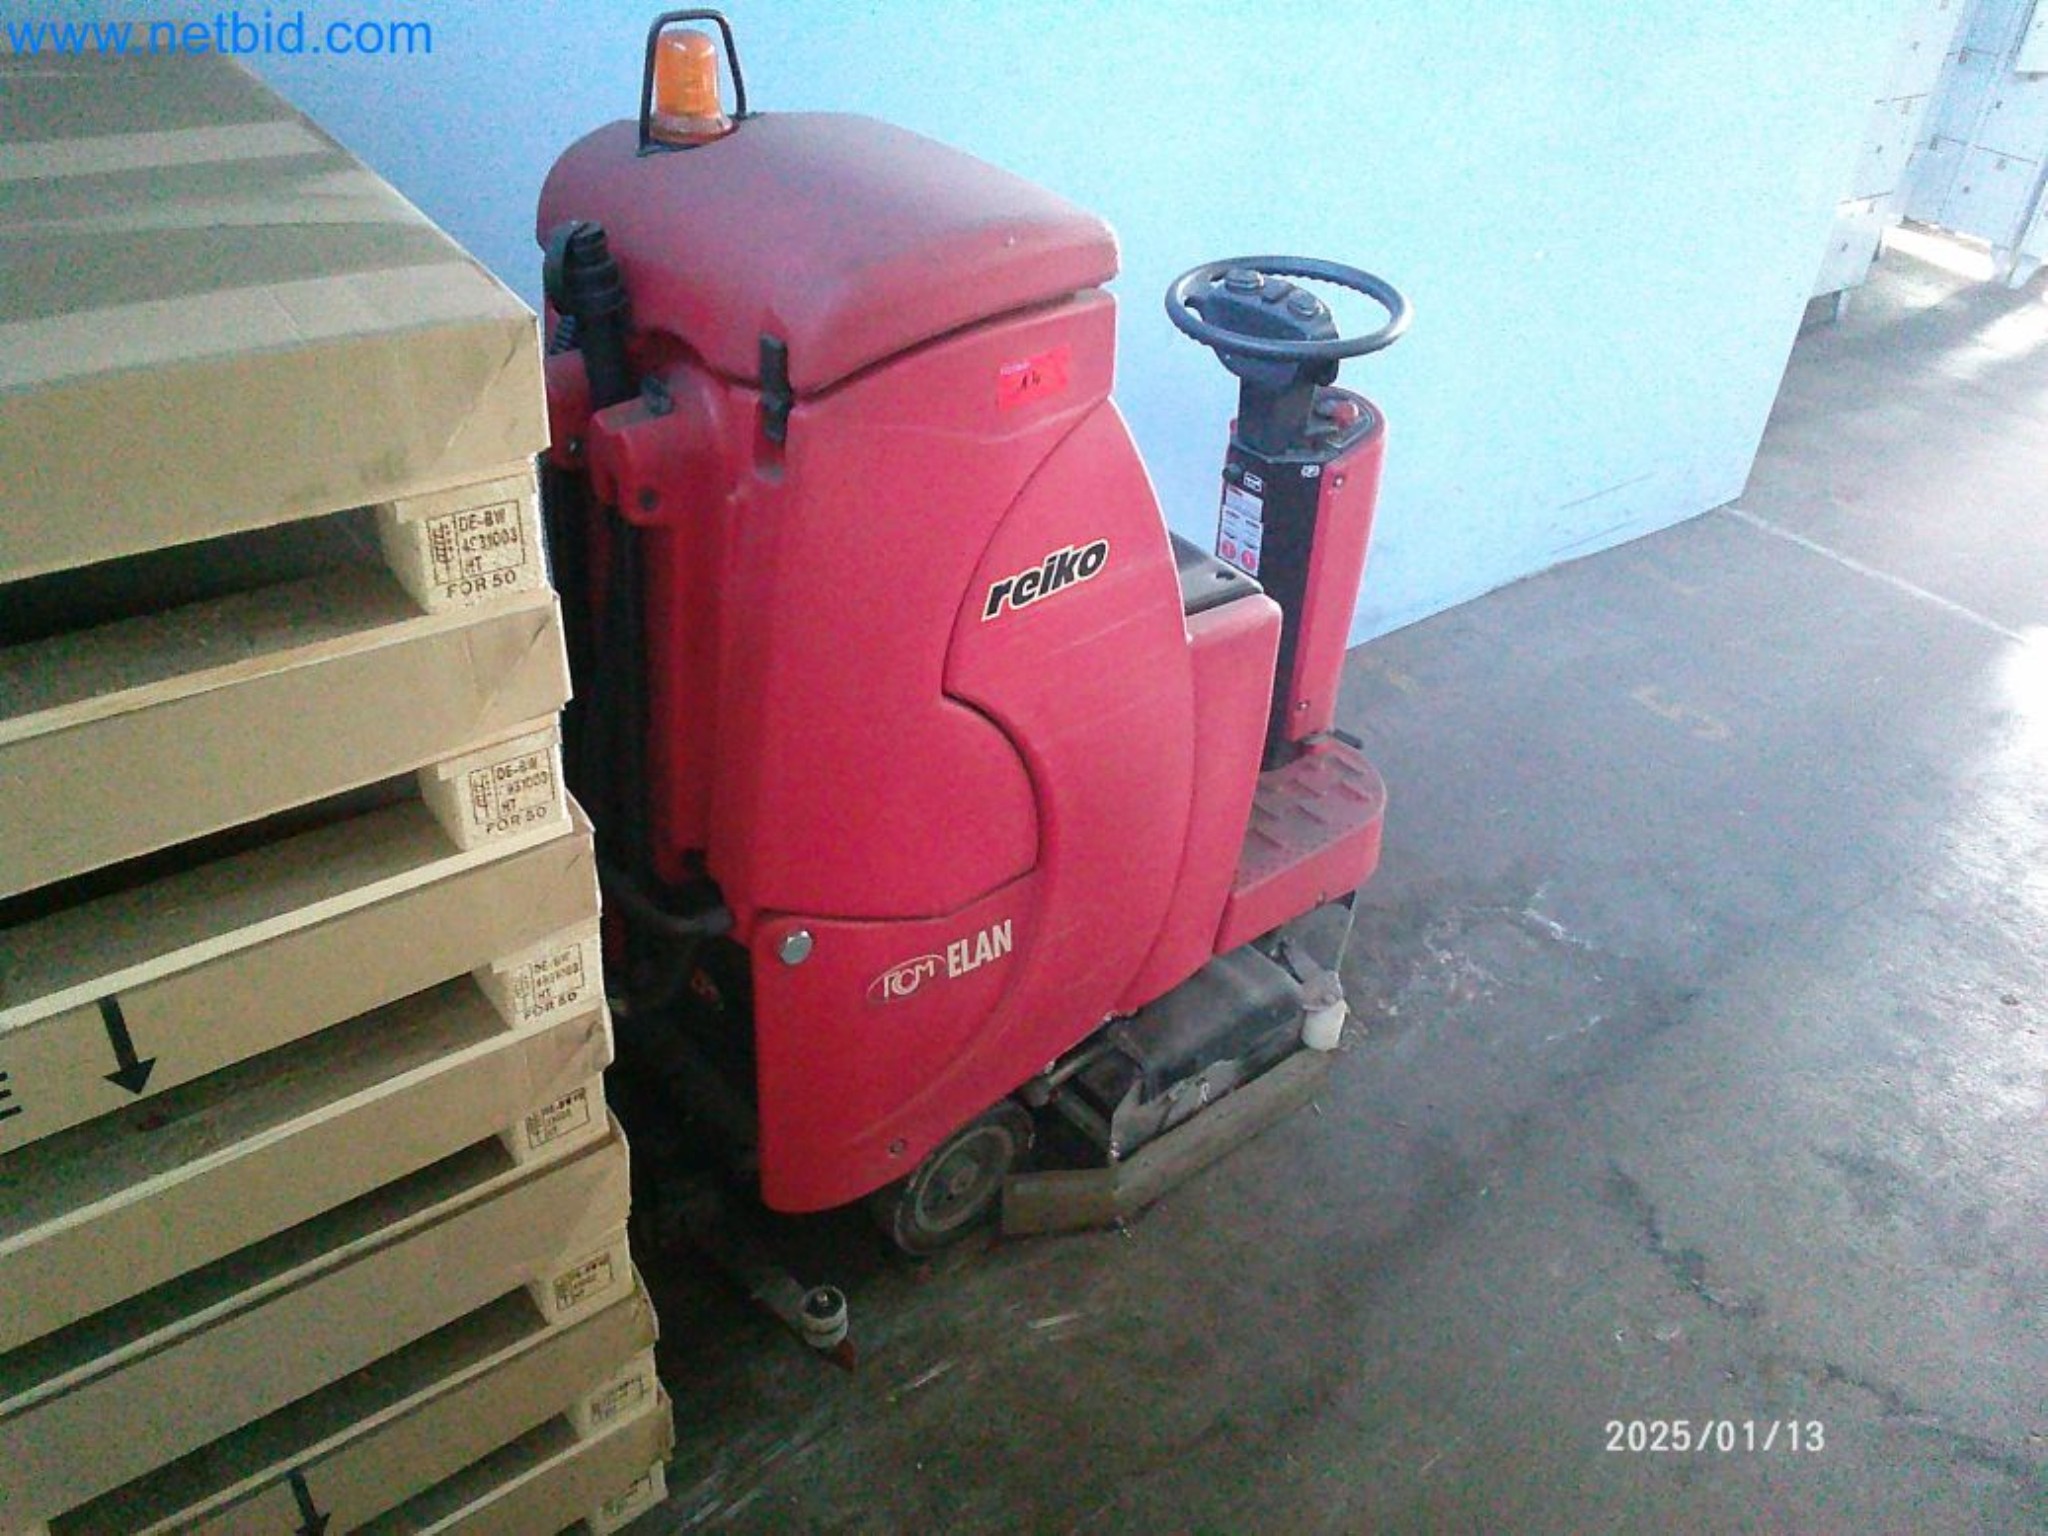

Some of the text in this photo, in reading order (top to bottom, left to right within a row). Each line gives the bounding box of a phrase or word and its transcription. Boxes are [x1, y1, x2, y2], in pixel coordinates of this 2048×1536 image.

[447, 569, 517, 599] FOR 50
[982, 540, 1108, 619] reiko
[486, 814, 521, 834] FOR
[947, 918, 1013, 979] ELAN
